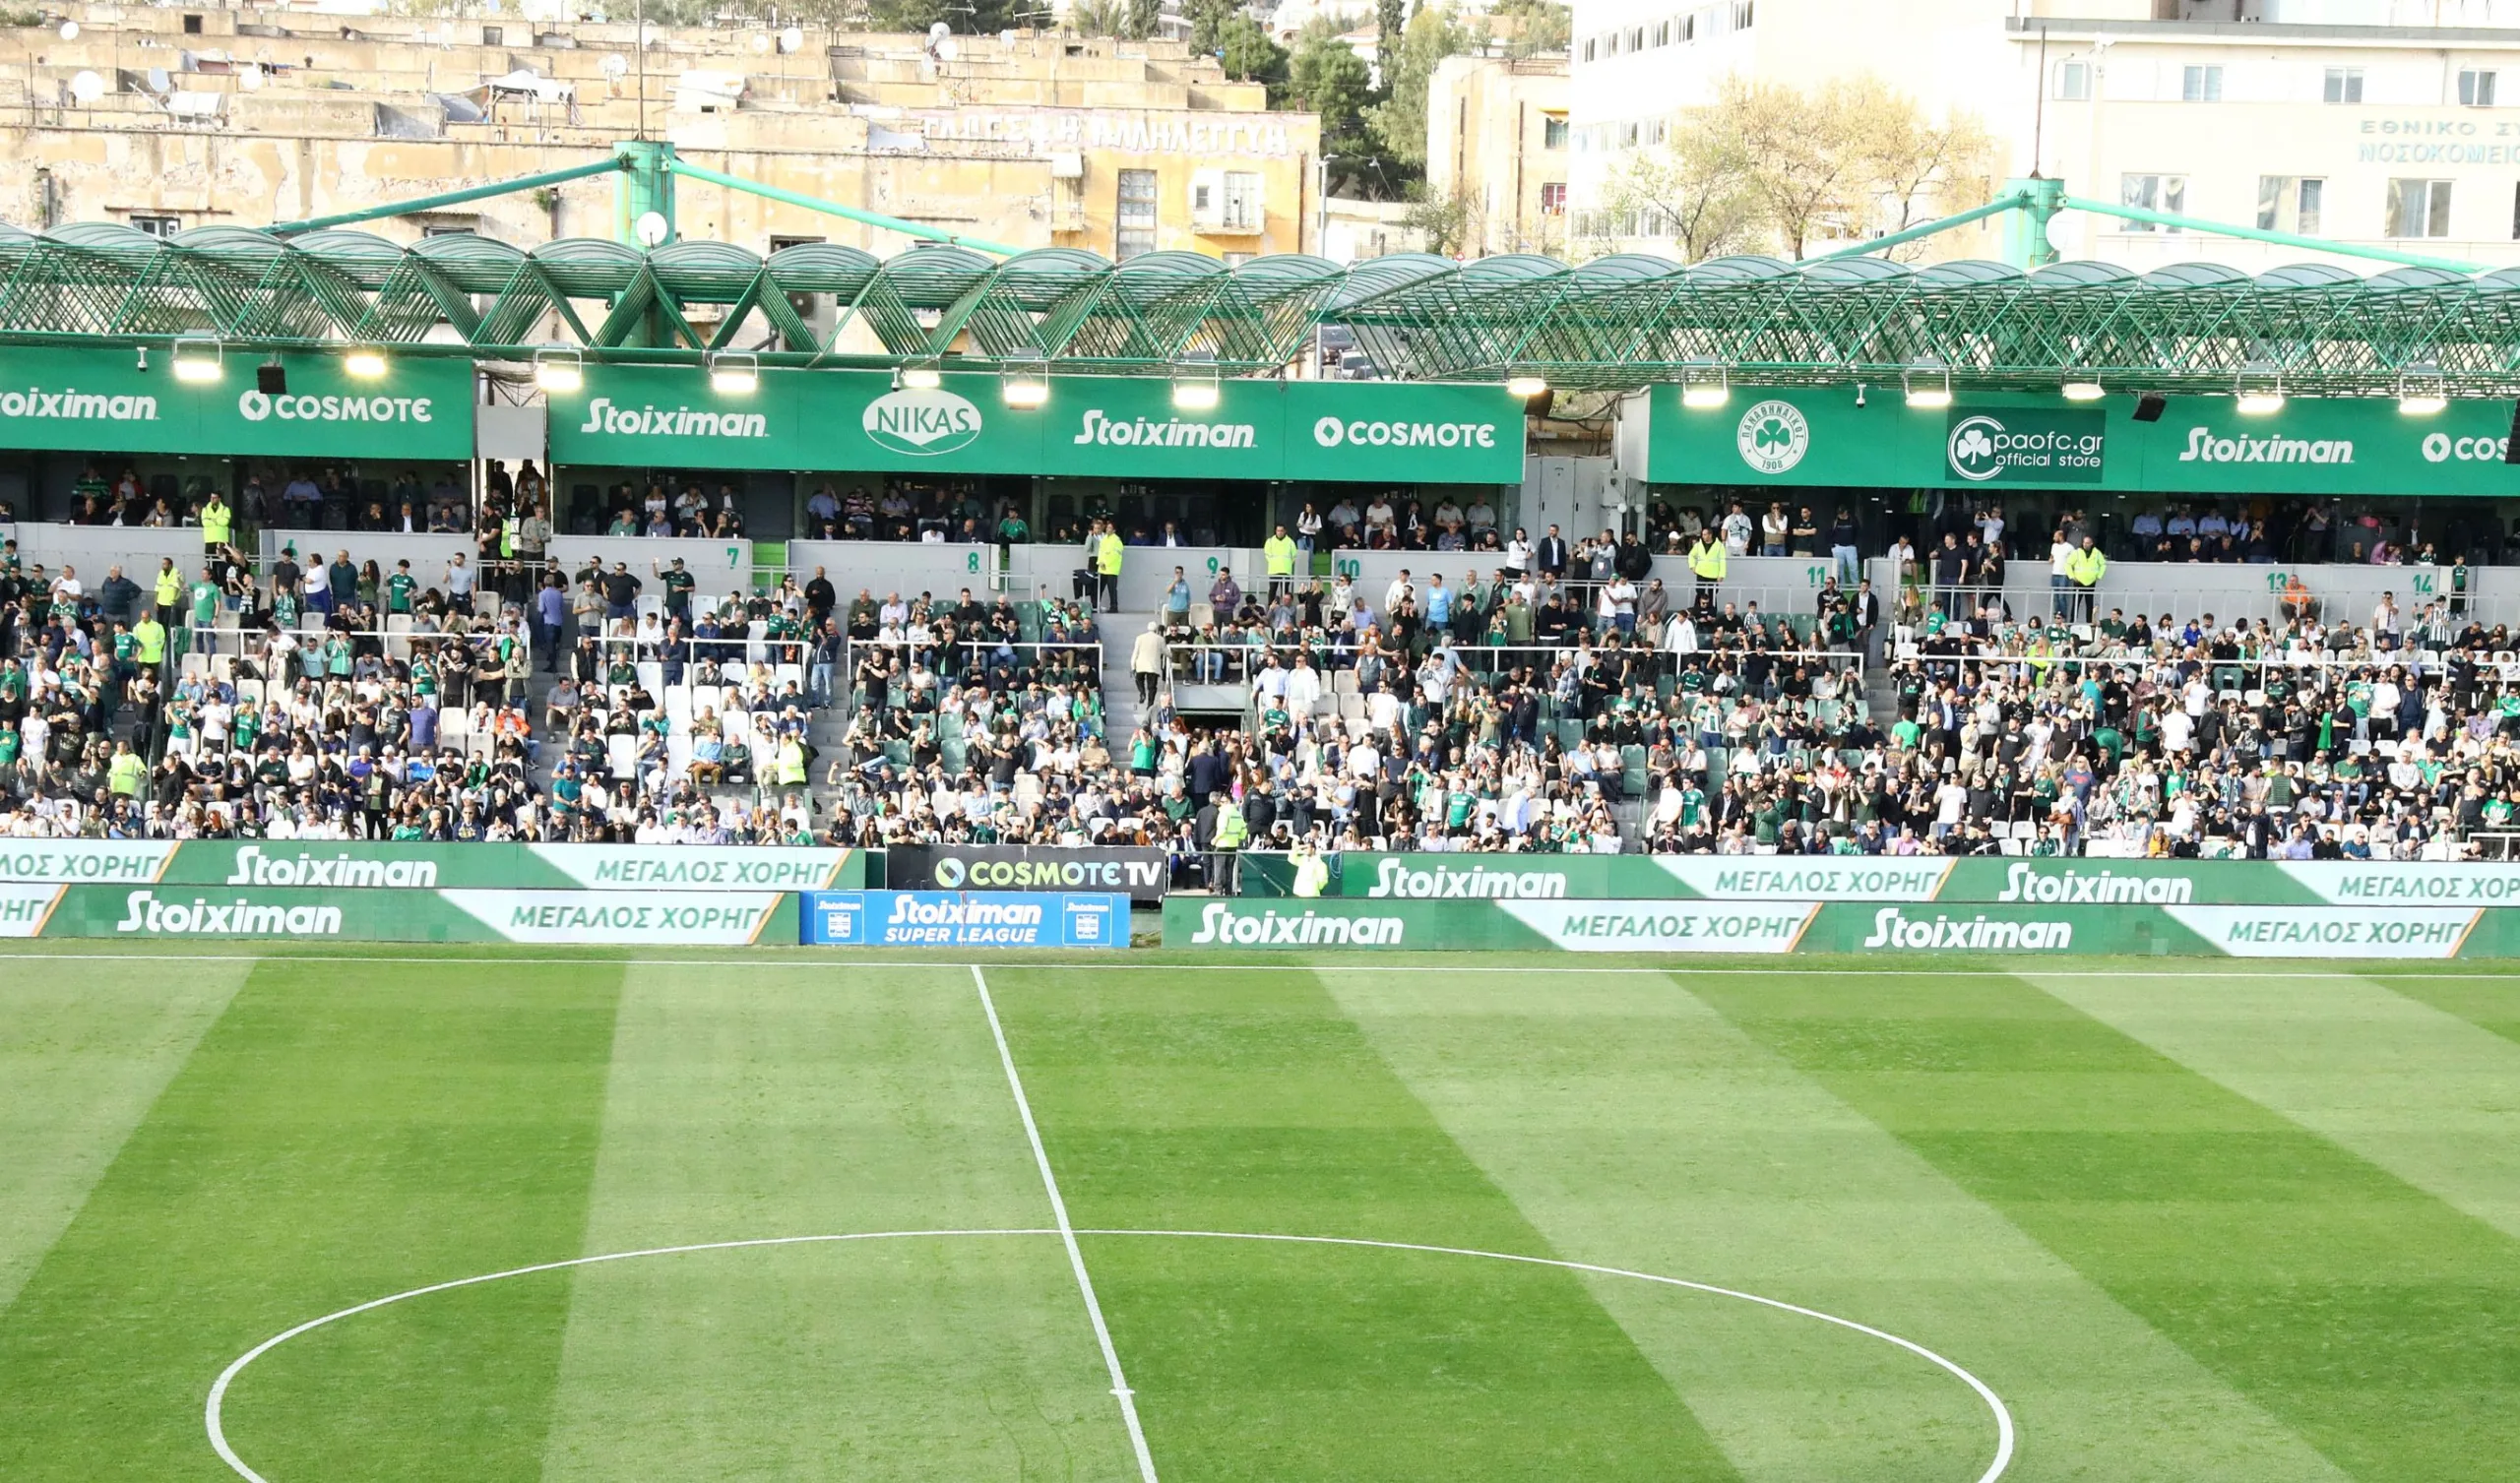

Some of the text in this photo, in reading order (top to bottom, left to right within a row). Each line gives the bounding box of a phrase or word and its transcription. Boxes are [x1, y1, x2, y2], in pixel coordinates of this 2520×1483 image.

[2360, 119, 2478, 136] ΕΘΝΙΚΟ
[0, 387, 158, 419] oiximan
[276, 395, 432, 422] COSMOTE
[581, 398, 767, 437] Stoiximan
[877, 406, 971, 434] NIKAS
[1074, 409, 1255, 448] Stoiximan
[1348, 421, 1494, 448] COSMOTE
[1993, 431, 2104, 455] paofc.gr
[2178, 427, 2353, 463] Stoiximan
[1995, 453, 2102, 467] official store
[2455, 437, 2509, 461] COS
[1762, 460, 1783, 469] 1908
[727, 547, 738, 569] 7
[968, 551, 979, 574] 8
[1207, 556, 1219, 578] 9
[1338, 559, 1359, 581] 10
[1807, 566, 1825, 588] 11
[2267, 572, 2287, 590] 13
[2413, 574, 2433, 595] 14
[59, 854, 165, 878] ΧΟΡΗΓ
[227, 845, 437, 887] Stoiximan
[596, 860, 837, 884] ΜΕΓΑΛΟΣ ΧΟΡΗΓ
[970, 860, 1162, 886] COSMOTE TV
[1368, 857, 1567, 897] Stoiximan
[1715, 871, 1943, 894] ΜΕΓΑΛΟΣ ΧΟΡΗΓ
[1998, 862, 2192, 903] Stoiximan
[2338, 876, 2463, 897] ΜΕΓΑΛΟΣ
[0, 899, 53, 921] ΗΓ
[117, 890, 342, 934] Stoiximan
[510, 905, 767, 930] ΜΕΓΑΛΟΣ ΧΟΡΗΓ
[888, 895, 1041, 925] Stoiximan
[884, 928, 1038, 943] SUPER LEAGUE
[1191, 902, 1405, 945] Stoiximan
[1562, 915, 1803, 938] ΜΕΓΑΛΟΣ ΧΟΡΗΓ
[1864, 907, 2072, 949] Stoiximan
[2228, 921, 2471, 944] ΜΕΓΑΛΟΣ ΧΟΡΗΓ
